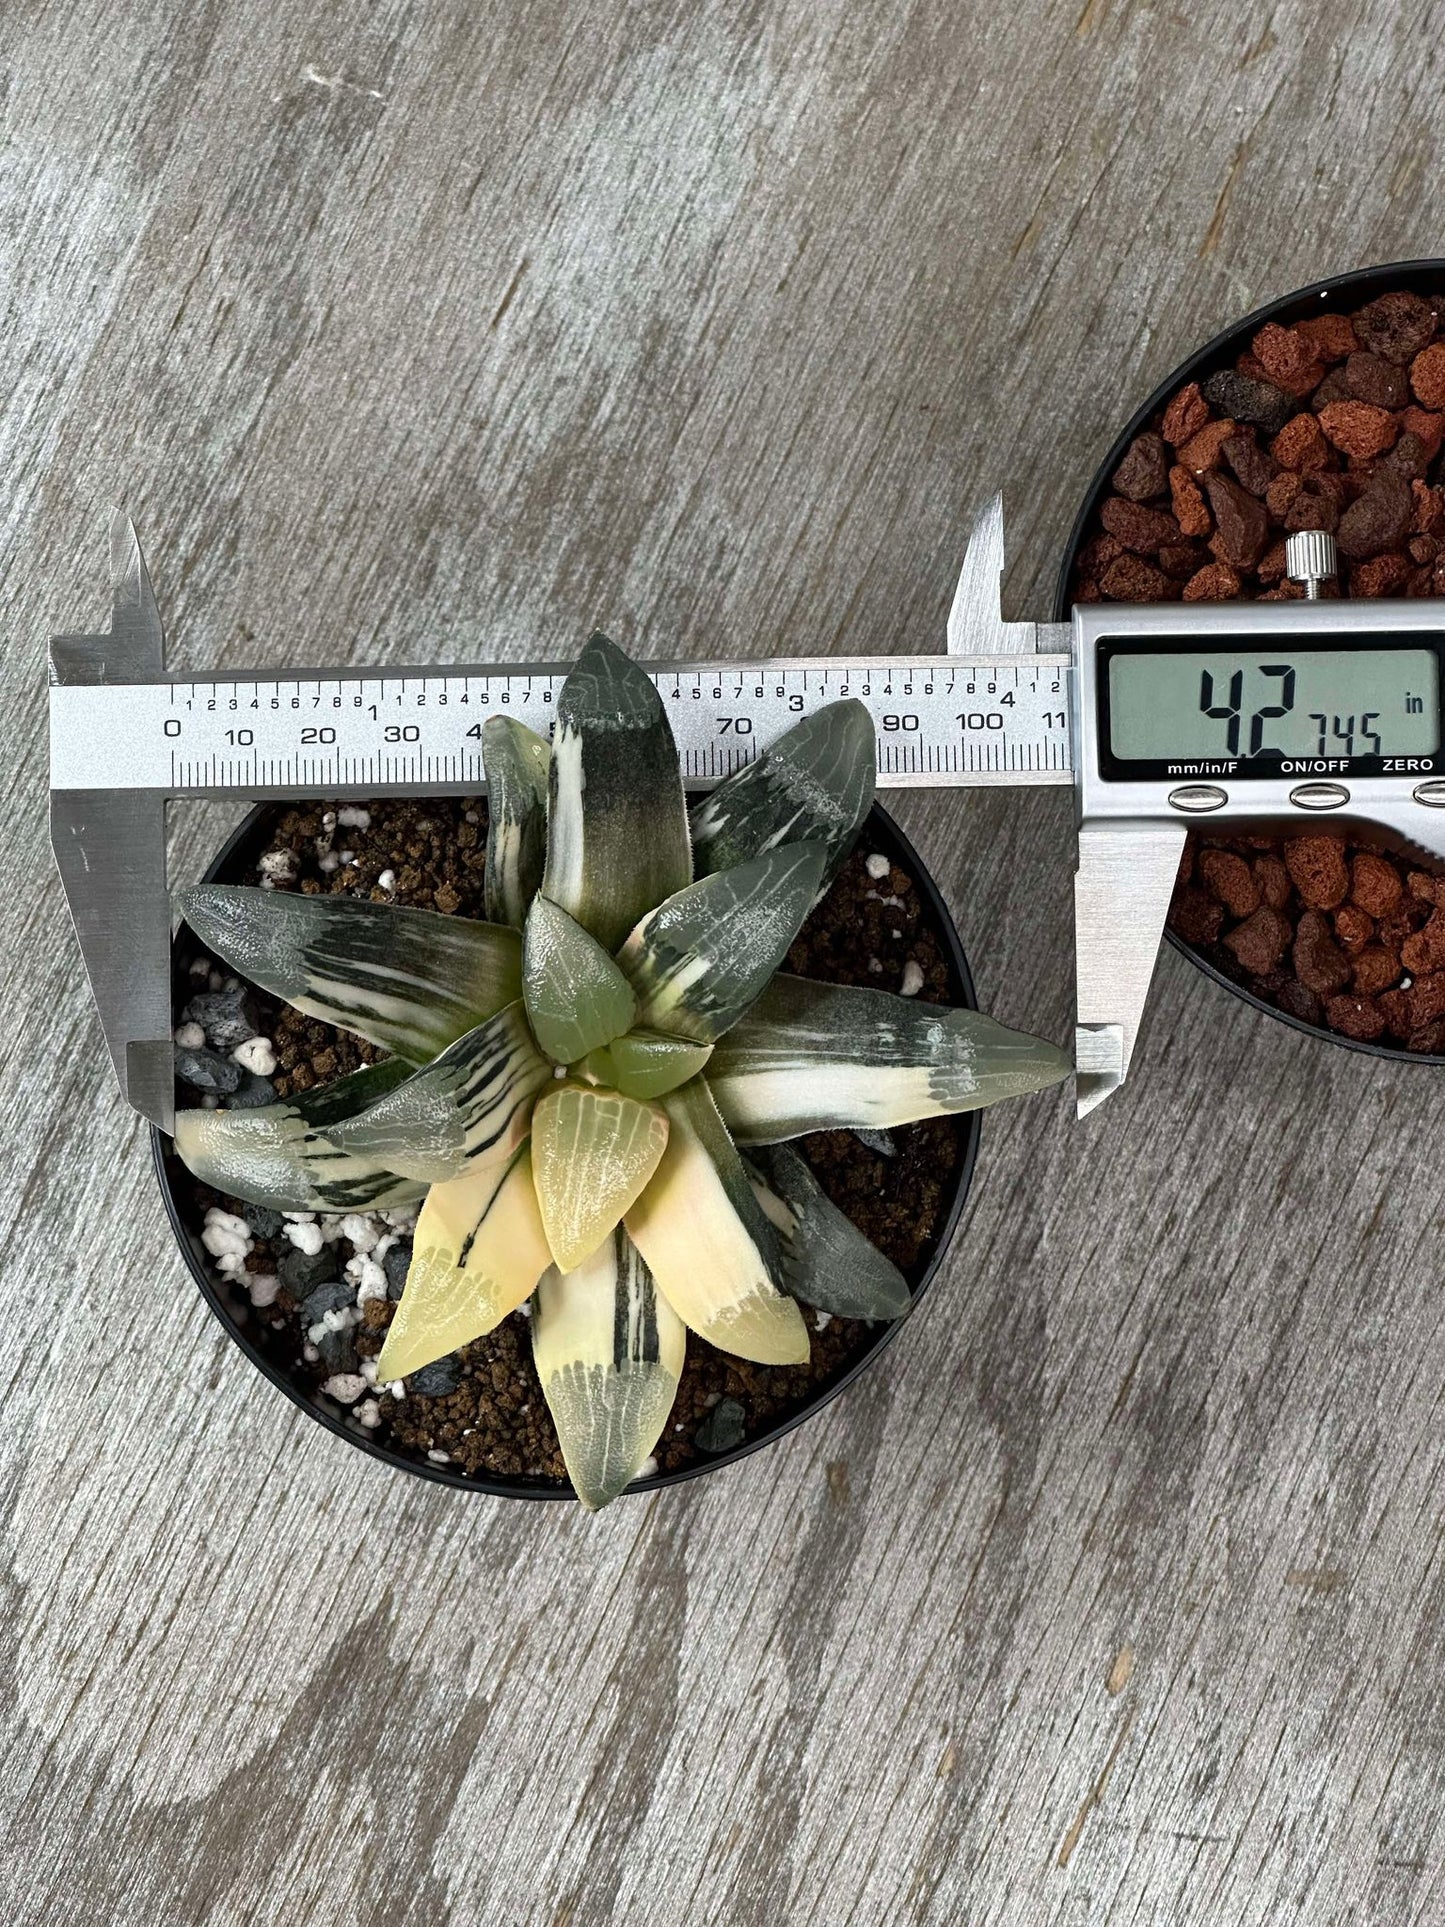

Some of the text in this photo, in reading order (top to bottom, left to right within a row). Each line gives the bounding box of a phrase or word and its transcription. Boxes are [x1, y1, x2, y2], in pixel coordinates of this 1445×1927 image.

[186, 691, 552, 721] 1 2 3 4 5 6 7 8 9 1 1 2 3 4 5 6 7 8
[671, 681, 1060, 712] 4 5 6 7 8 9 3 1 2 3 4 5 6 7 8 9 4 1 2
[1405, 691, 1424, 714] in
[163, 719, 182, 738] 0
[224, 729, 254, 746] 10
[300, 727, 337, 745] 20
[384, 725, 420, 743] 30
[716, 717, 753, 735] 70
[882, 714, 920, 732] 90
[955, 712, 1004, 730] 100
[1167, 761, 1238, 774] mm/in/F
[1280, 759, 1350, 774] ON/OFF
[1382, 758, 1434, 772] ZERO
